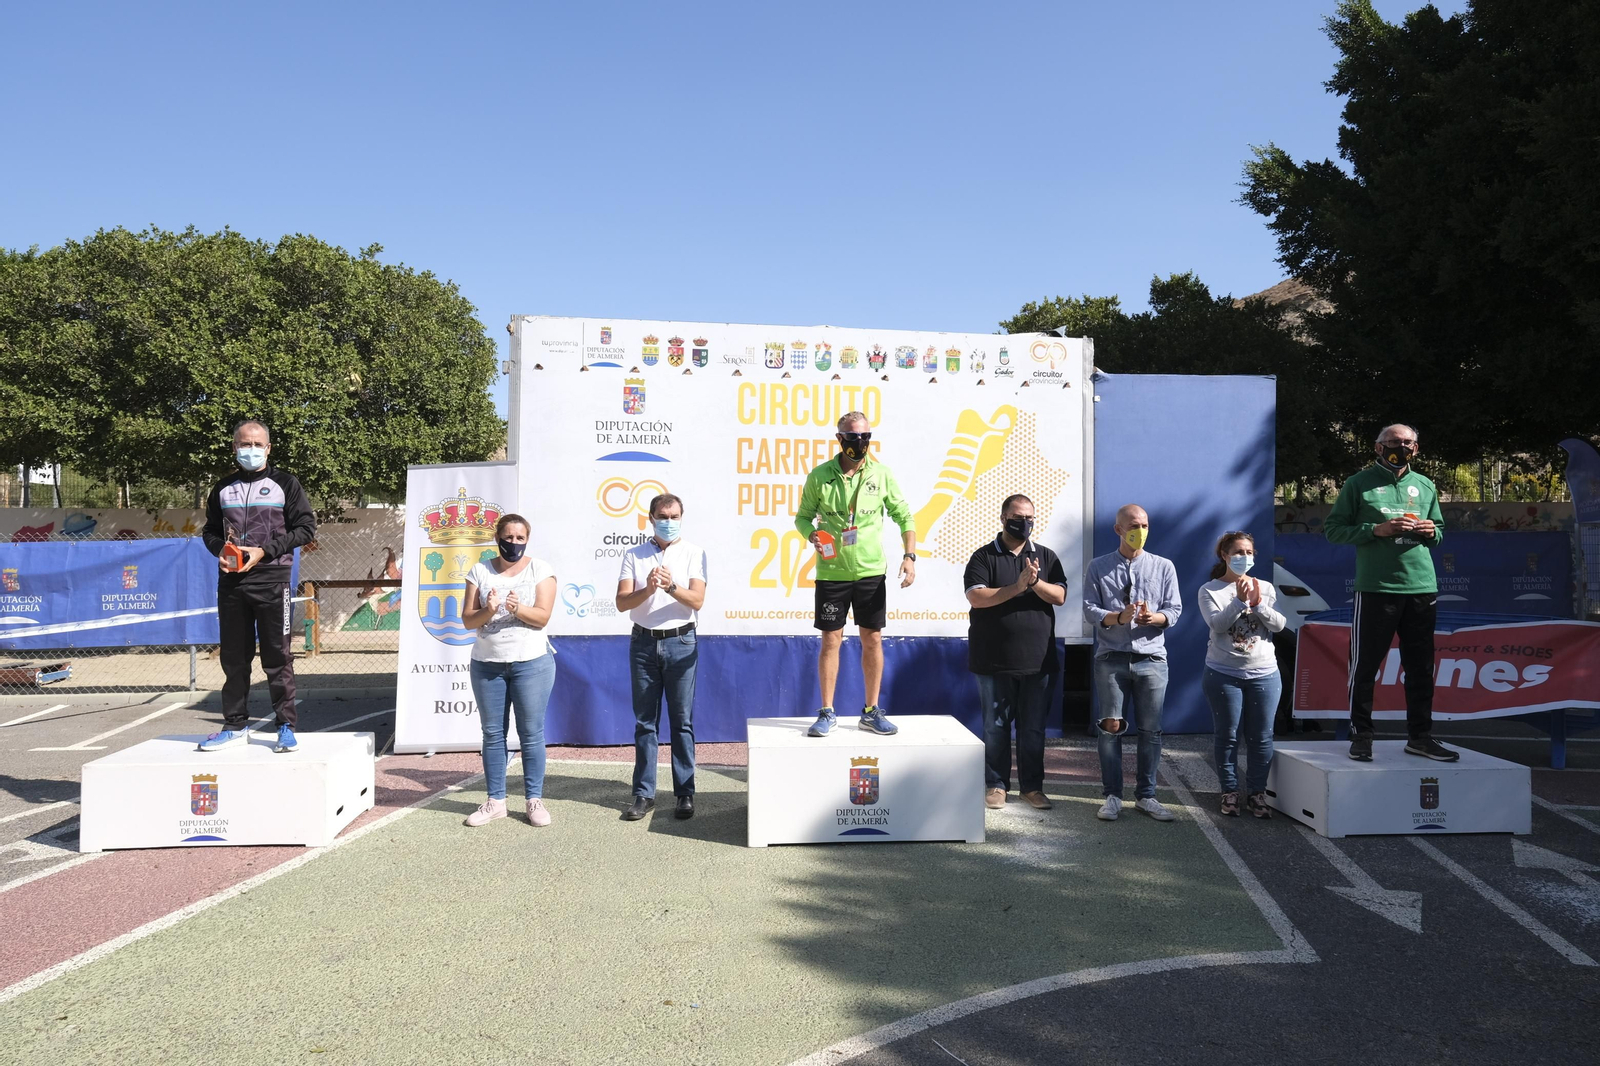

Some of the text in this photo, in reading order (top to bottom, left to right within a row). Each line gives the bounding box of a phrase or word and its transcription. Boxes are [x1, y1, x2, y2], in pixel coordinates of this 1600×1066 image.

[1032, 370, 1063, 378] circuitos
[737, 382, 881, 428] CIRCUITO
[595, 420, 673, 432] DIPUTACIÓN
[597, 433, 671, 445] DE ALMERÍA
[181, 516, 198, 534] de
[1512, 575, 1552, 583] DIPUTACIÓN
[0, 595, 42, 604] UTACIÓN
[102, 592, 157, 602] DIPUTACIÓN
[0, 603, 40, 613] ALMERÍA
[102, 602, 156, 611] DE ALMERÍA
[1483, 645, 1495, 654] &
[1500, 645, 1554, 659] SHOES
[411, 663, 471, 674] AYUNTAM
[451, 682, 468, 691] DE
[835, 807, 890, 817] DIPUTACIÓN
[179, 818, 229, 827] DIPUTACIÓN
[837, 816, 888, 825] DE ALMERÍA
[193, 826, 228, 835] ALMERÍA
